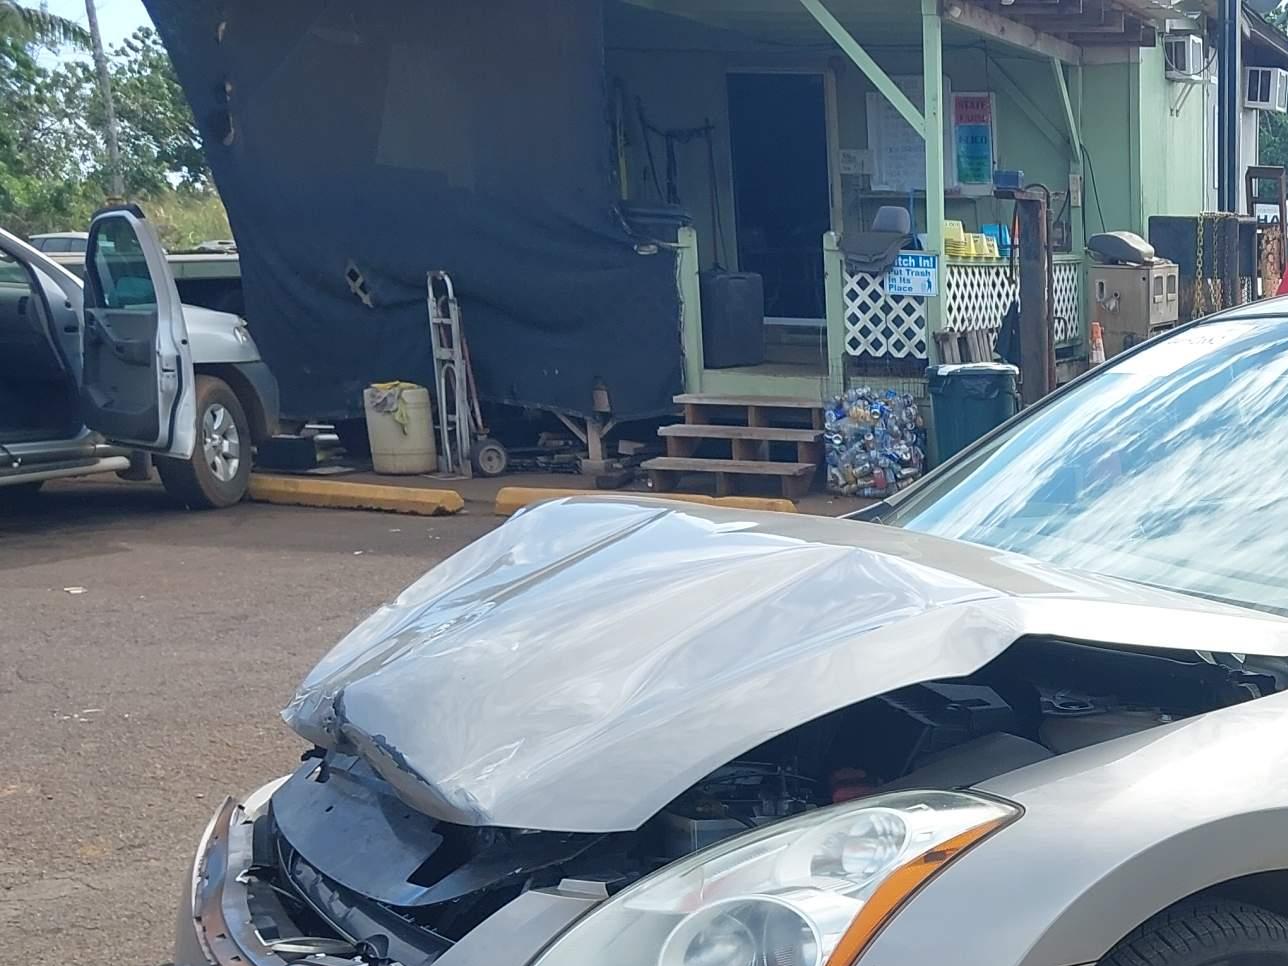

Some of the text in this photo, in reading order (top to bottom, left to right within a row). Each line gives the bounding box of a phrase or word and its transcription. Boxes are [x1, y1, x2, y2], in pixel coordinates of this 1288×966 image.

[895, 256, 933, 268] itch In!
[905, 269, 931, 277] Trash
[900, 276, 911, 284] Its
[889, 284, 913, 292] Place
